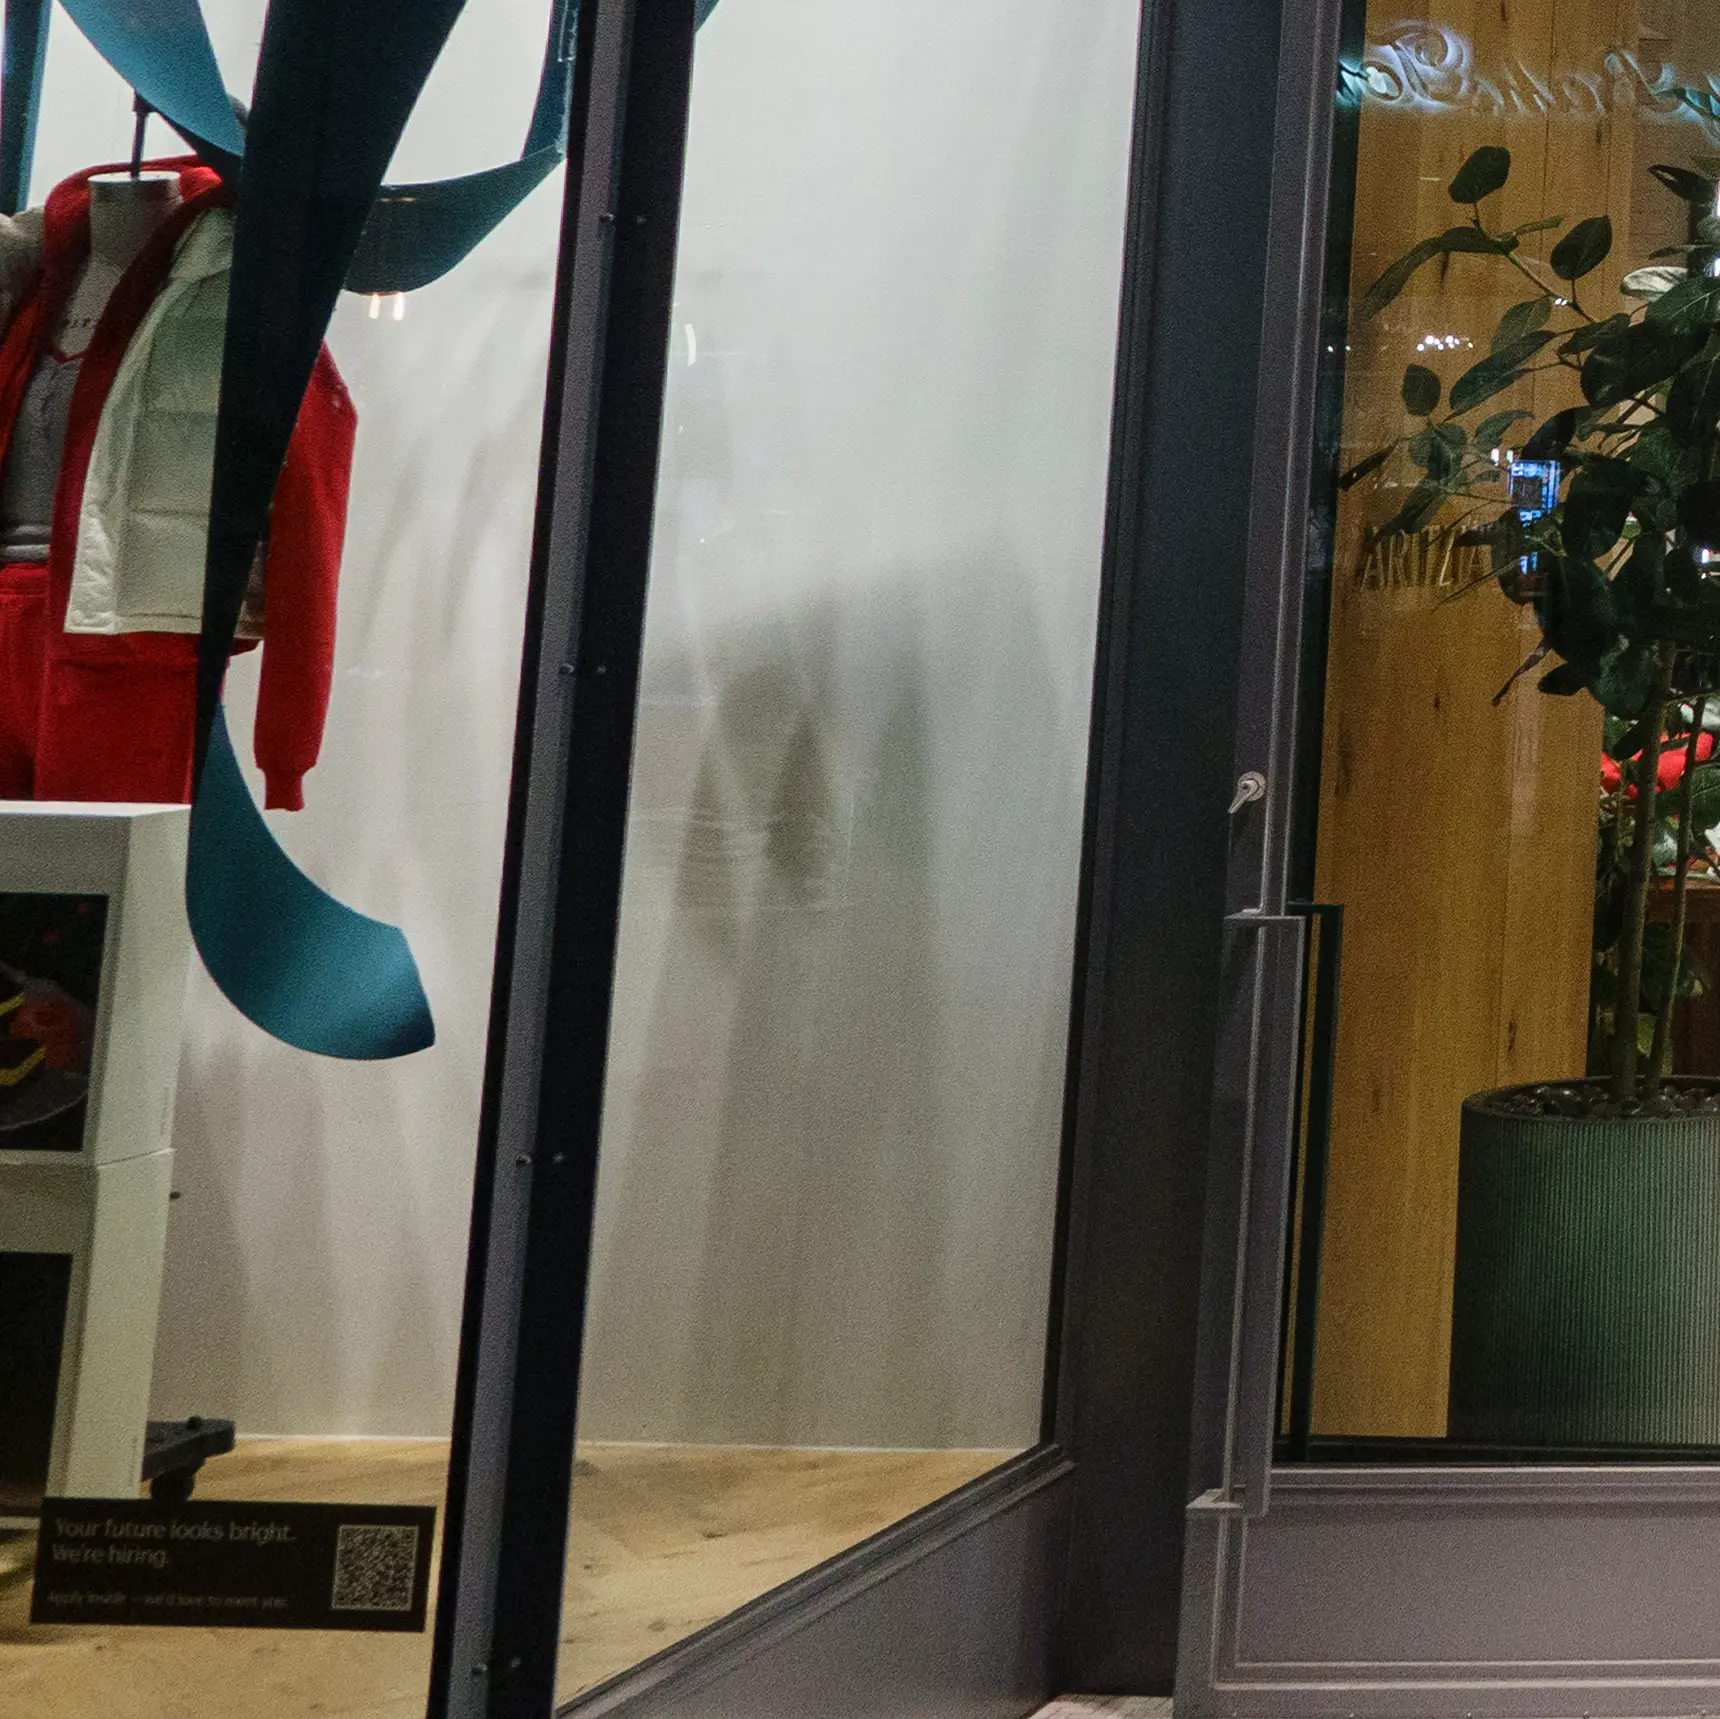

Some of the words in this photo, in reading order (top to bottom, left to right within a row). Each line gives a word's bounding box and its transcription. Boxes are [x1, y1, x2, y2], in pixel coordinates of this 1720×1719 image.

[55, 1519, 99, 1539] Your
[104, 1519, 166, 1540] future
[170, 1519, 224, 1541] looks
[228, 1521, 297, 1545] bright.
[51, 1544, 105, 1565] We're
